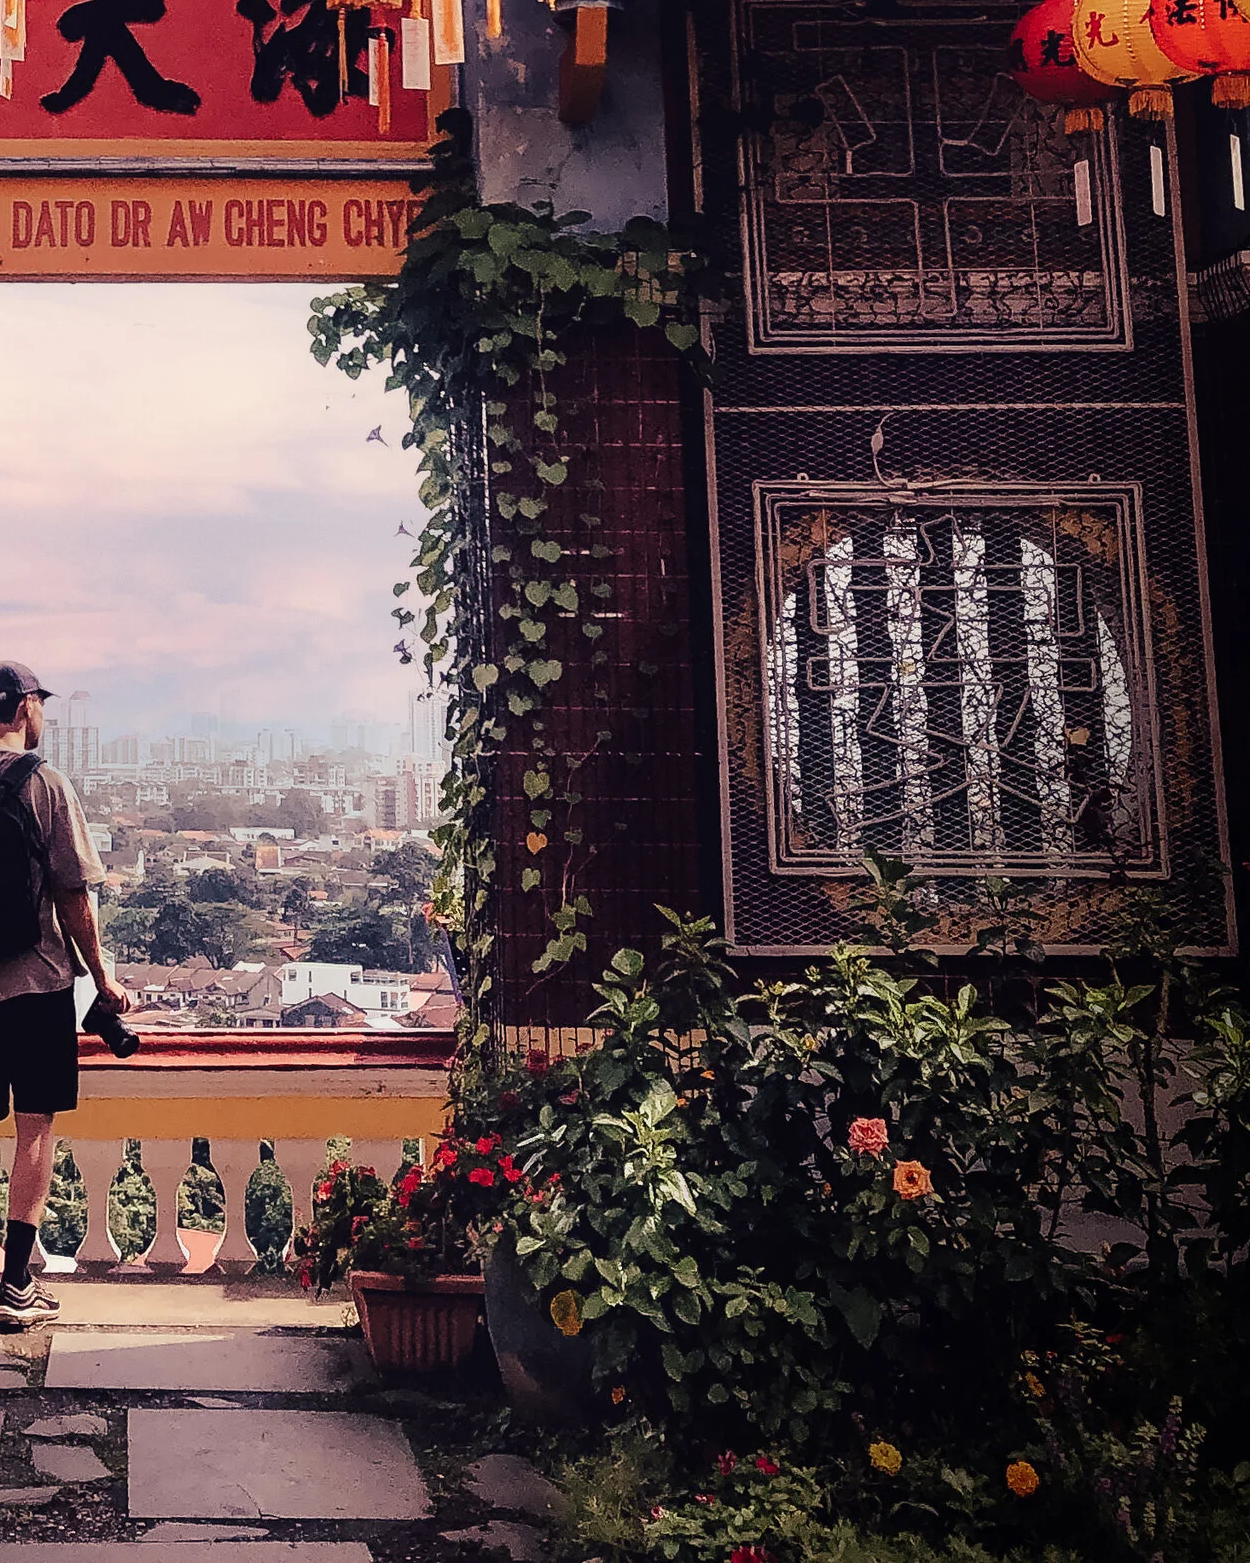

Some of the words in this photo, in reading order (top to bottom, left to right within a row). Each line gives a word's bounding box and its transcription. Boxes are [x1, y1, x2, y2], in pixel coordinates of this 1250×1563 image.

[12, 200, 96, 249] DATO
[110, 199, 152, 249] DR
[166, 199, 214, 249] AW
[224, 199, 327, 249] CHENG
